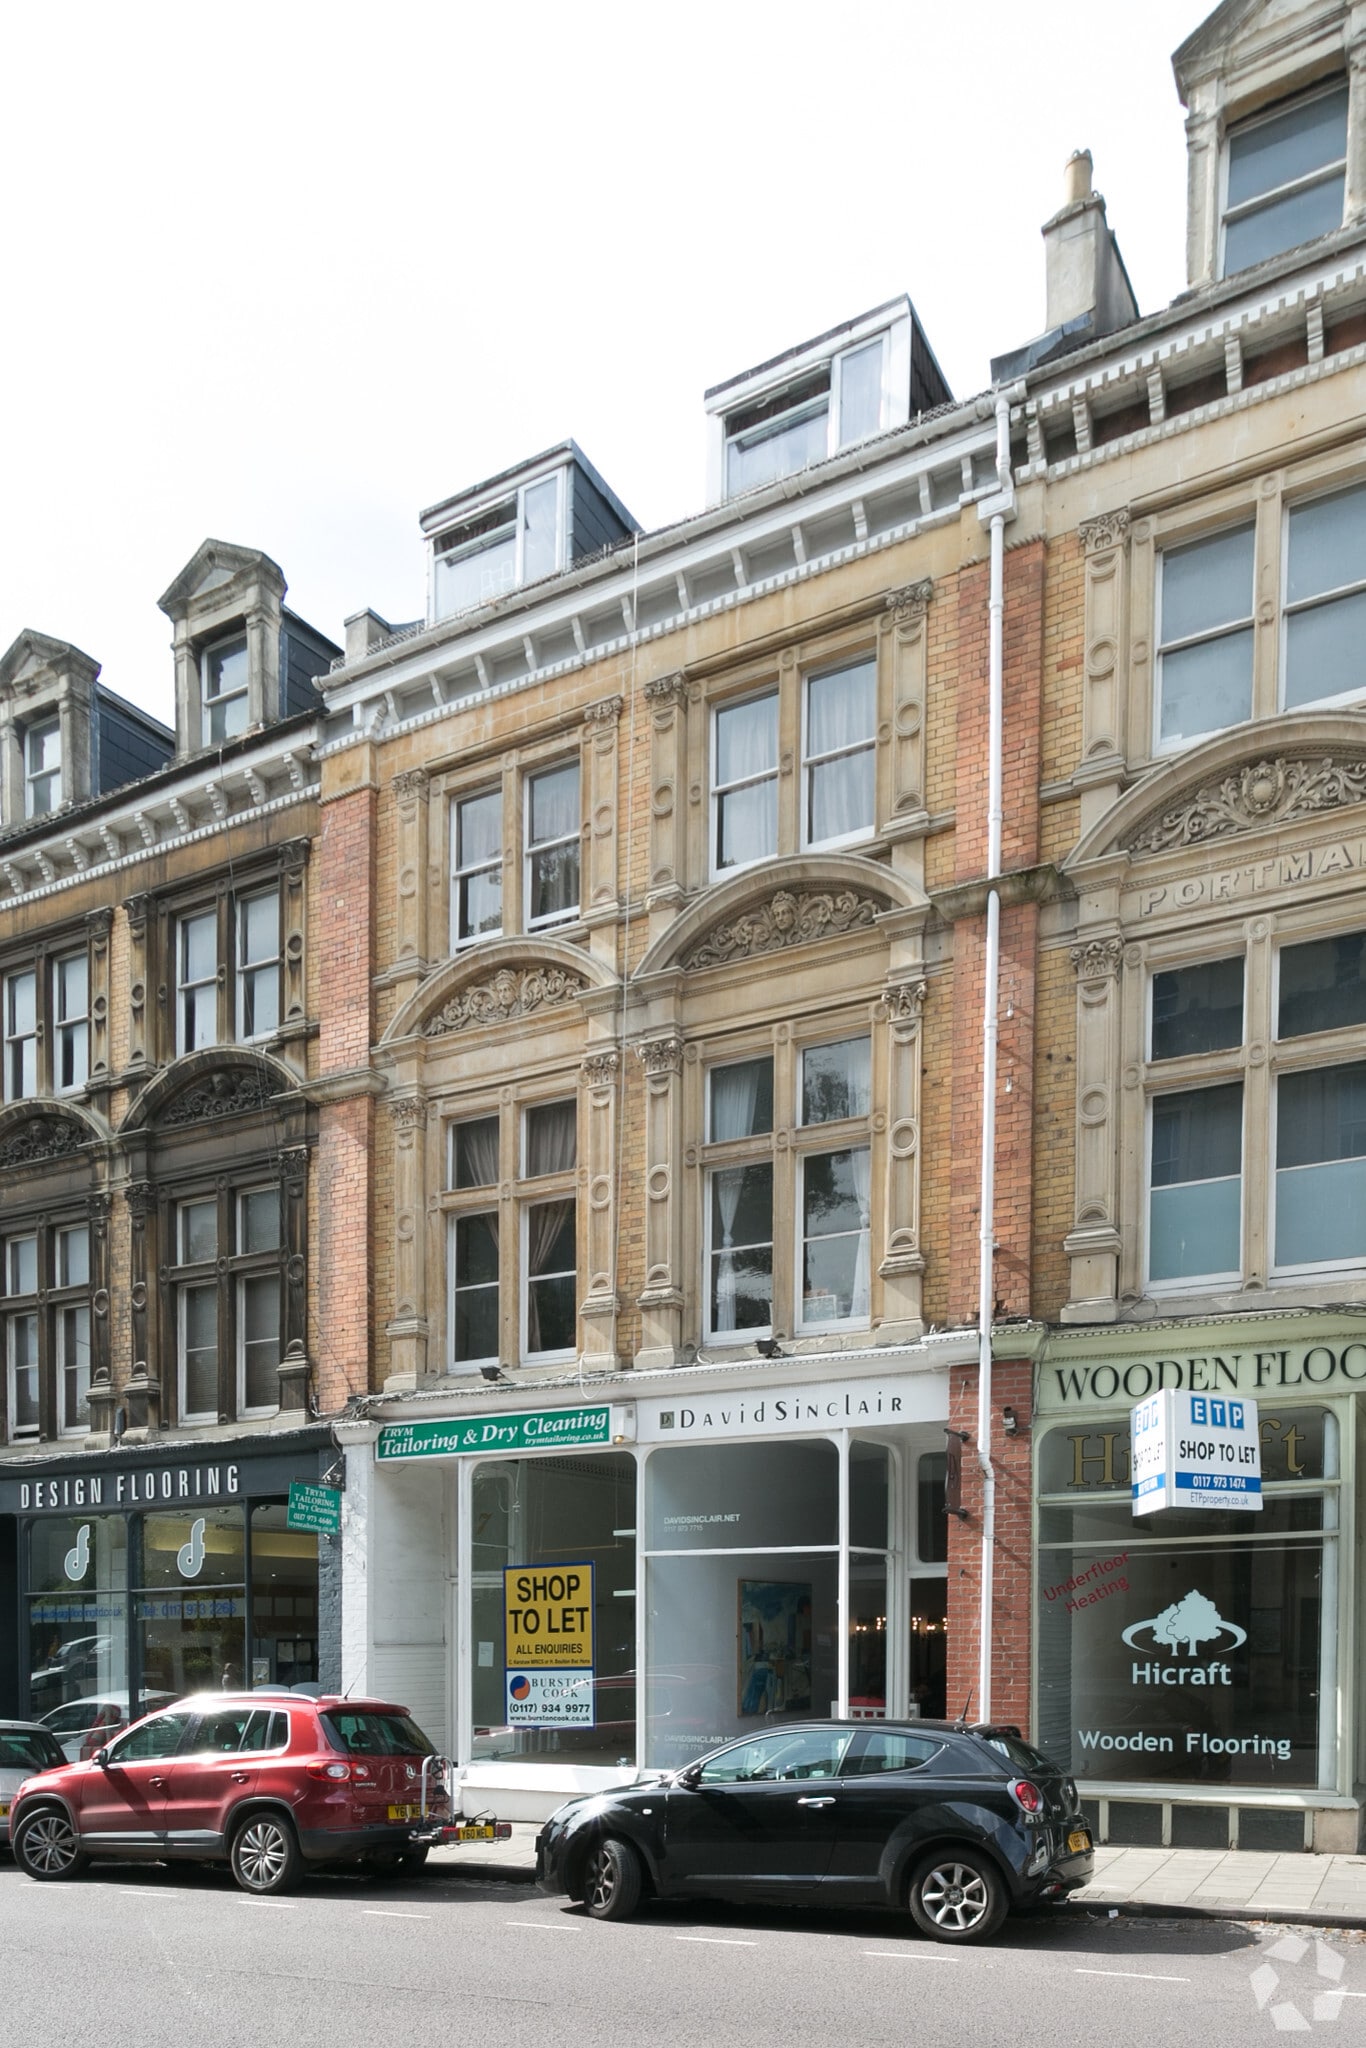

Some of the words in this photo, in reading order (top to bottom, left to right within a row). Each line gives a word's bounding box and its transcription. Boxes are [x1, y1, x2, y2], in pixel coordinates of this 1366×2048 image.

[1139, 843, 1366, 918] PORTMA
[1055, 1354, 1242, 1401] WOODEN
[1253, 1344, 1366, 1387] FLOO
[1193, 1400, 1243, 1427] ETP
[381, 1433, 458, 1456] Tailoring
[463, 1429, 478, 1445] &
[481, 1424, 518, 1442] Dry
[523, 1411, 607, 1436] Cleaning
[383, 1427, 414, 1438] TRYM
[524, 1432, 605, 1446] trymtailoring.co.uk
[1180, 1440, 1215, 1461] SHOP
[1219, 1443, 1235, 1462] TO
[1239, 1446, 1256, 1464] LET
[21, 1478, 101, 1509] DESIGN
[117, 1465, 238, 1501] FLOORING
[305, 1487, 326, 1498] TRYM
[1192, 1476, 1211, 1488] 0117
[1213, 1477, 1227, 1489] 973
[1229, 1477, 1246, 1489] 1474
[294, 1493, 335, 1508] TAILORING
[298, 1503, 309, 1513] Dry
[311, 1505, 338, 1517] Cleaning
[1190, 1491, 1249, 1507] ETPproperty.co.uk
[663, 1513, 741, 1525] DAVIDSINCLAIR.NET
[1043, 1551, 1129, 1601] Underfloor
[517, 1574, 580, 1602] SHOP
[1064, 1576, 1130, 1614] Heating
[508, 1608, 540, 1634] TO
[547, 1607, 589, 1633] LET
[516, 1644, 532, 1654] ALL
[535, 1643, 583, 1655] ENQUIRIES
[1132, 1662, 1232, 1685] Hicraft
[509, 1703, 537, 1713] (0117)
[541, 1703, 560, 1713] 934
[565, 1703, 590, 1713] 9977
[1078, 1730, 1174, 1752] Wooden
[1187, 1733, 1292, 1760] Flooring
[461, 1829, 475, 1840] Y60
[477, 1829, 489, 1839] MEL
